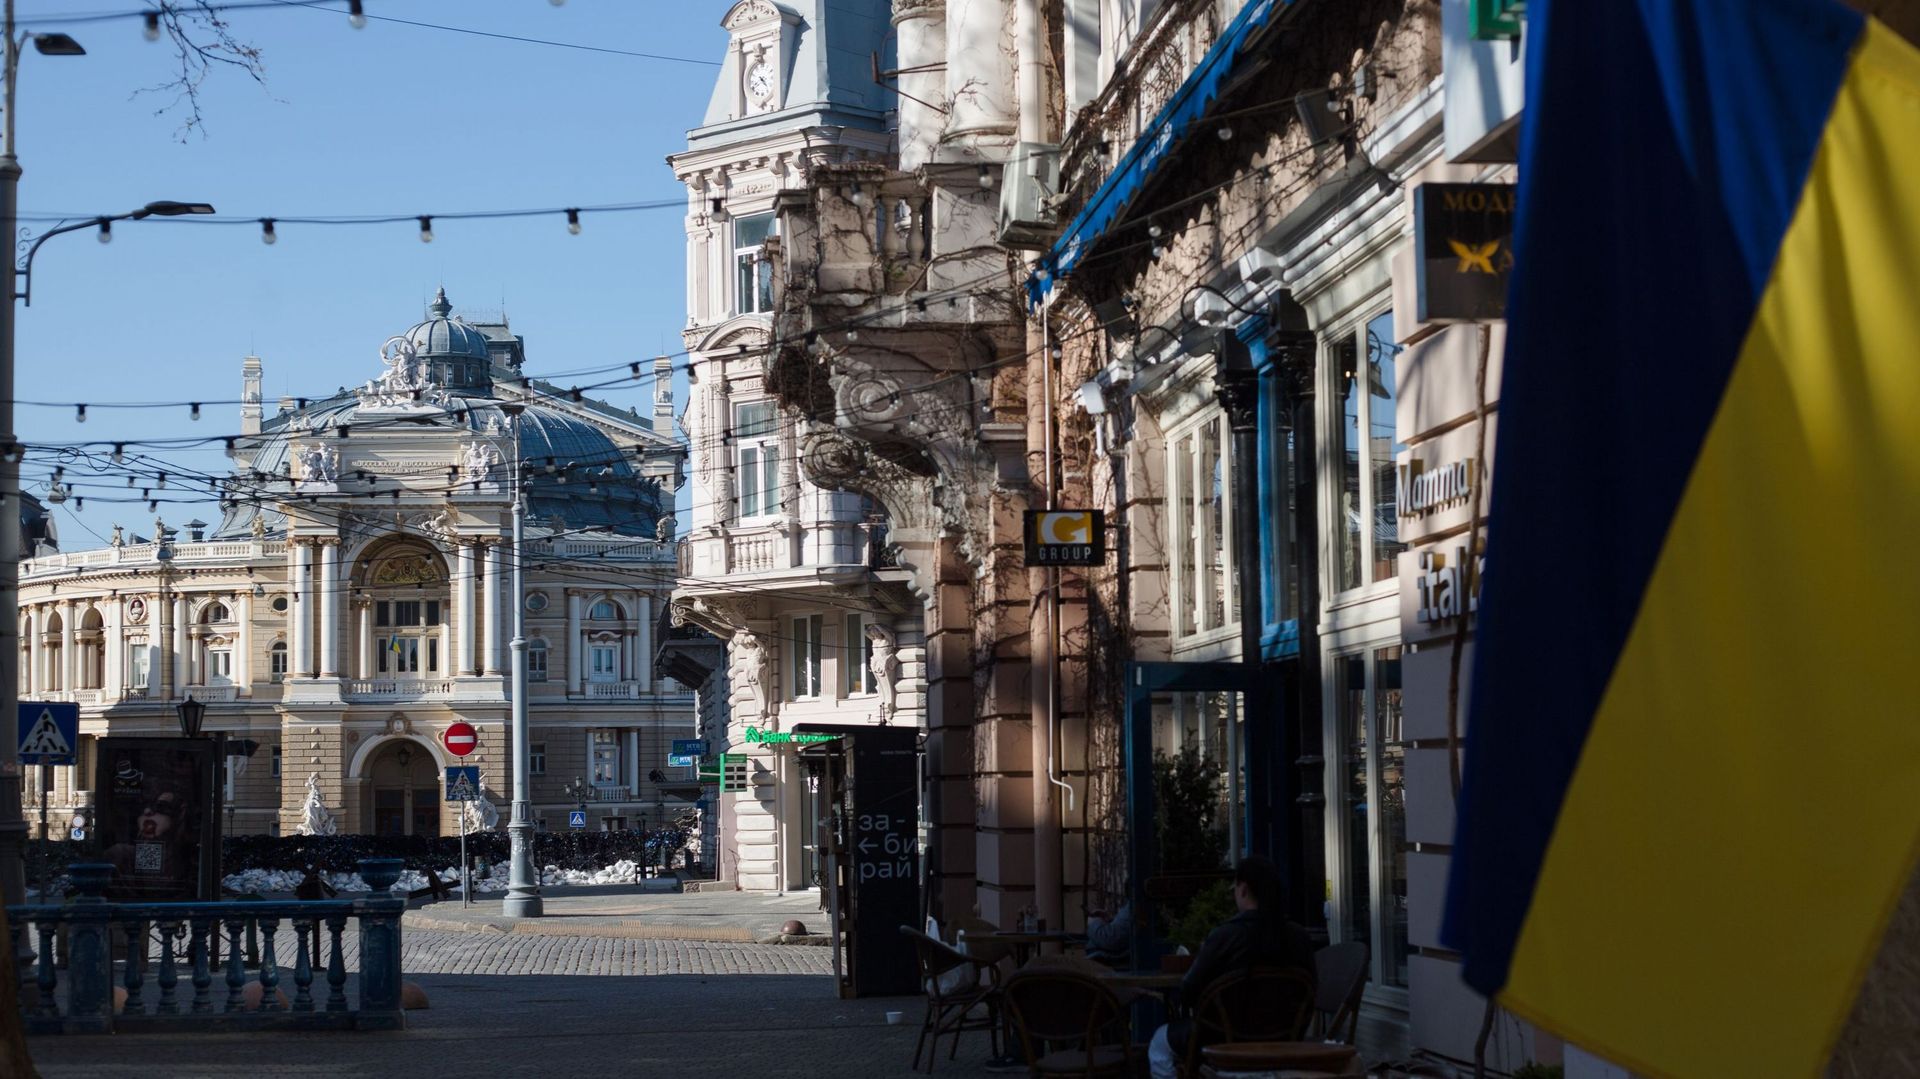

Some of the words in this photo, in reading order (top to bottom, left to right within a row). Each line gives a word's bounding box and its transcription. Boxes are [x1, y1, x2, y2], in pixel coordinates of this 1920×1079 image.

[1396, 458, 1470, 517] Mamma
[1039, 546, 1091, 560] GROUP
[860, 855, 912, 885] рай
